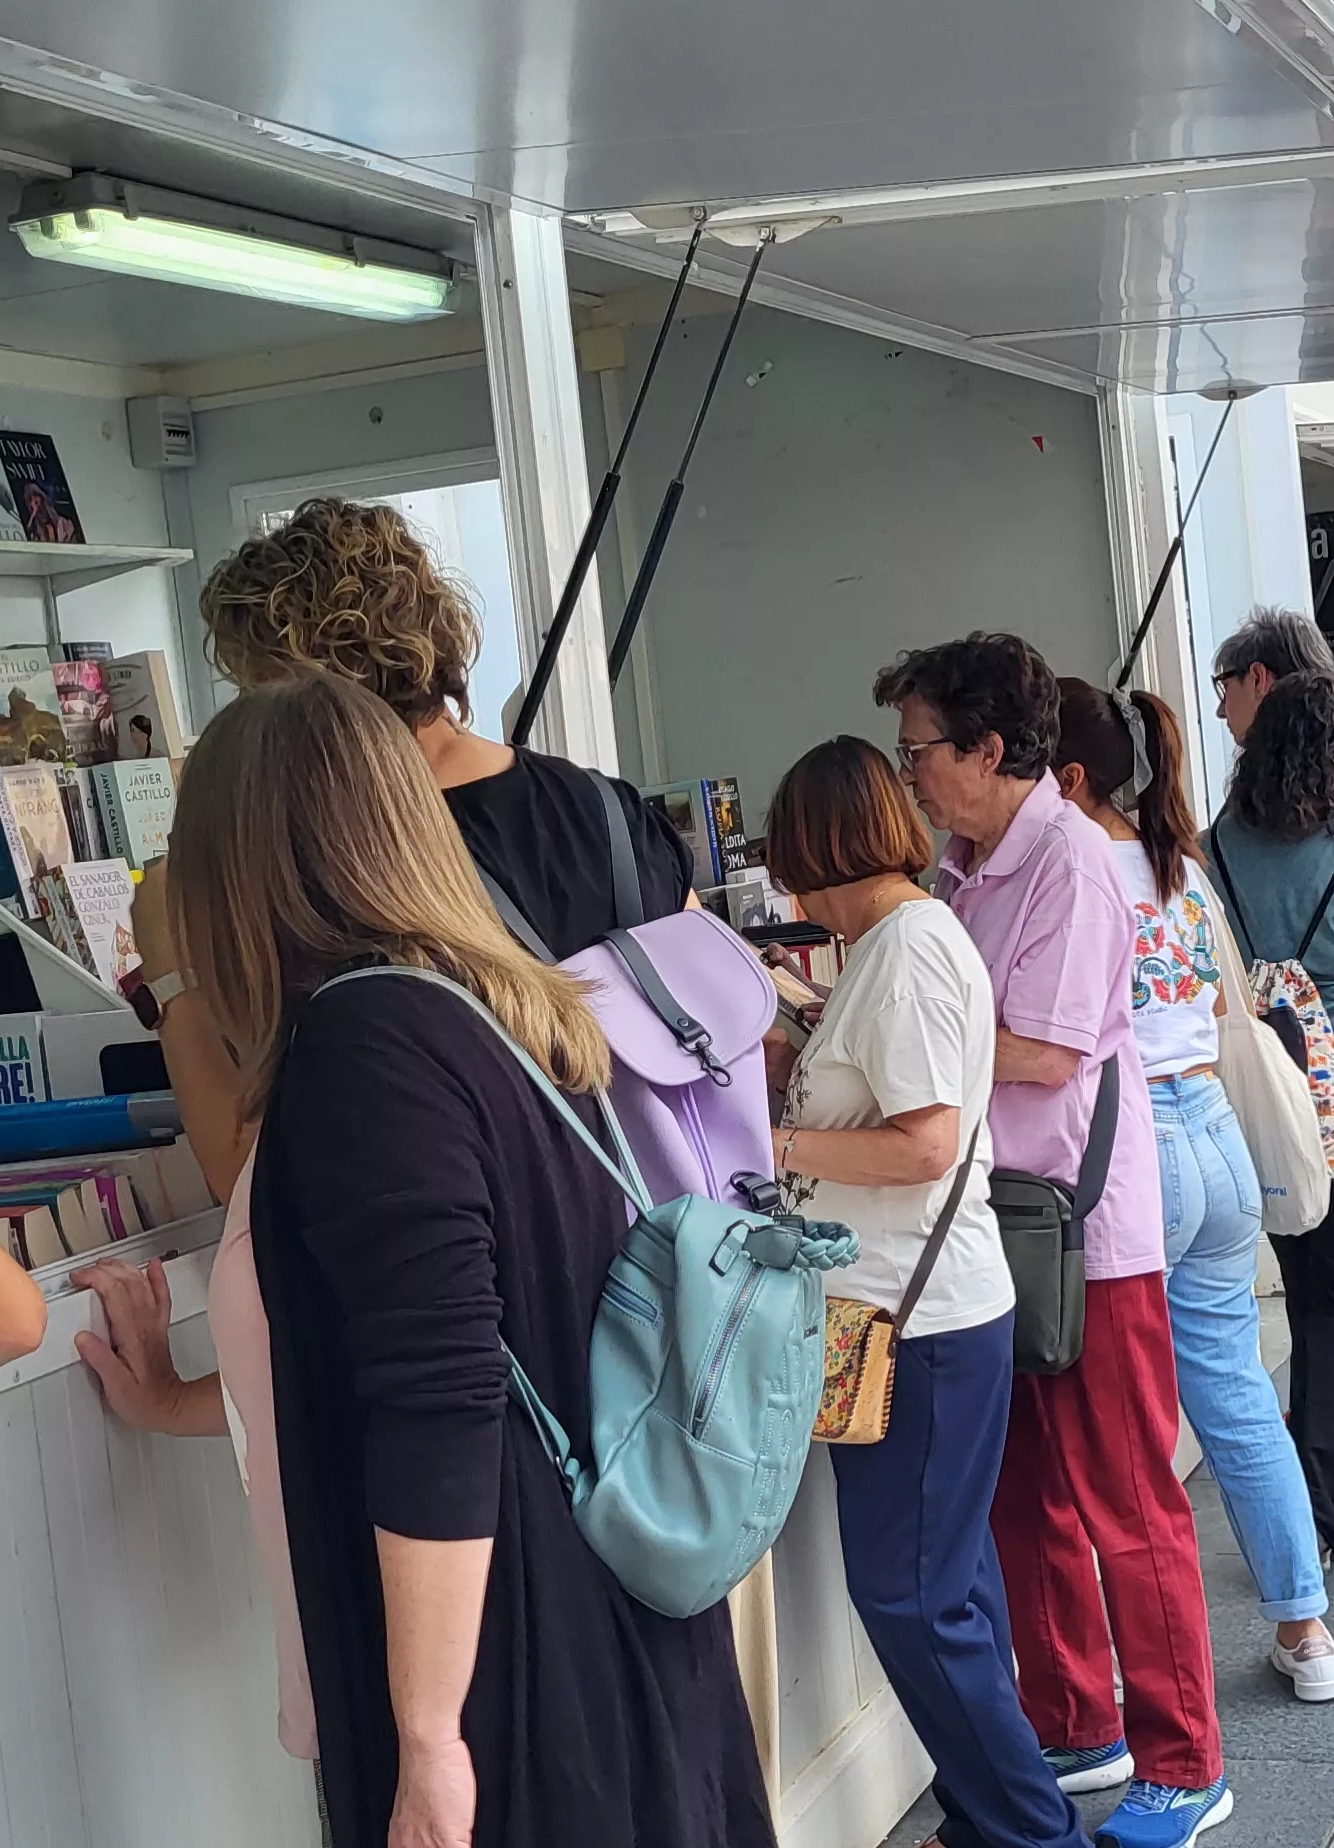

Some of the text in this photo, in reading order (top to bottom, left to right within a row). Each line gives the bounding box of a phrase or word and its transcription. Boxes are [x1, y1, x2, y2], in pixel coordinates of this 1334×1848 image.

[5, 462, 47, 482] SWIFT
[128, 773, 163, 787] JAVIER
[125, 787, 171, 802] CASTILLO
[100, 773, 124, 854] JAVIER CASTILLO
[69, 871, 126, 887] EL SANADOR
[74, 884, 130, 900] DE CABALLOS
[78, 899, 120, 913] GONZALO
[1260, 1185, 1288, 1197] yoral
